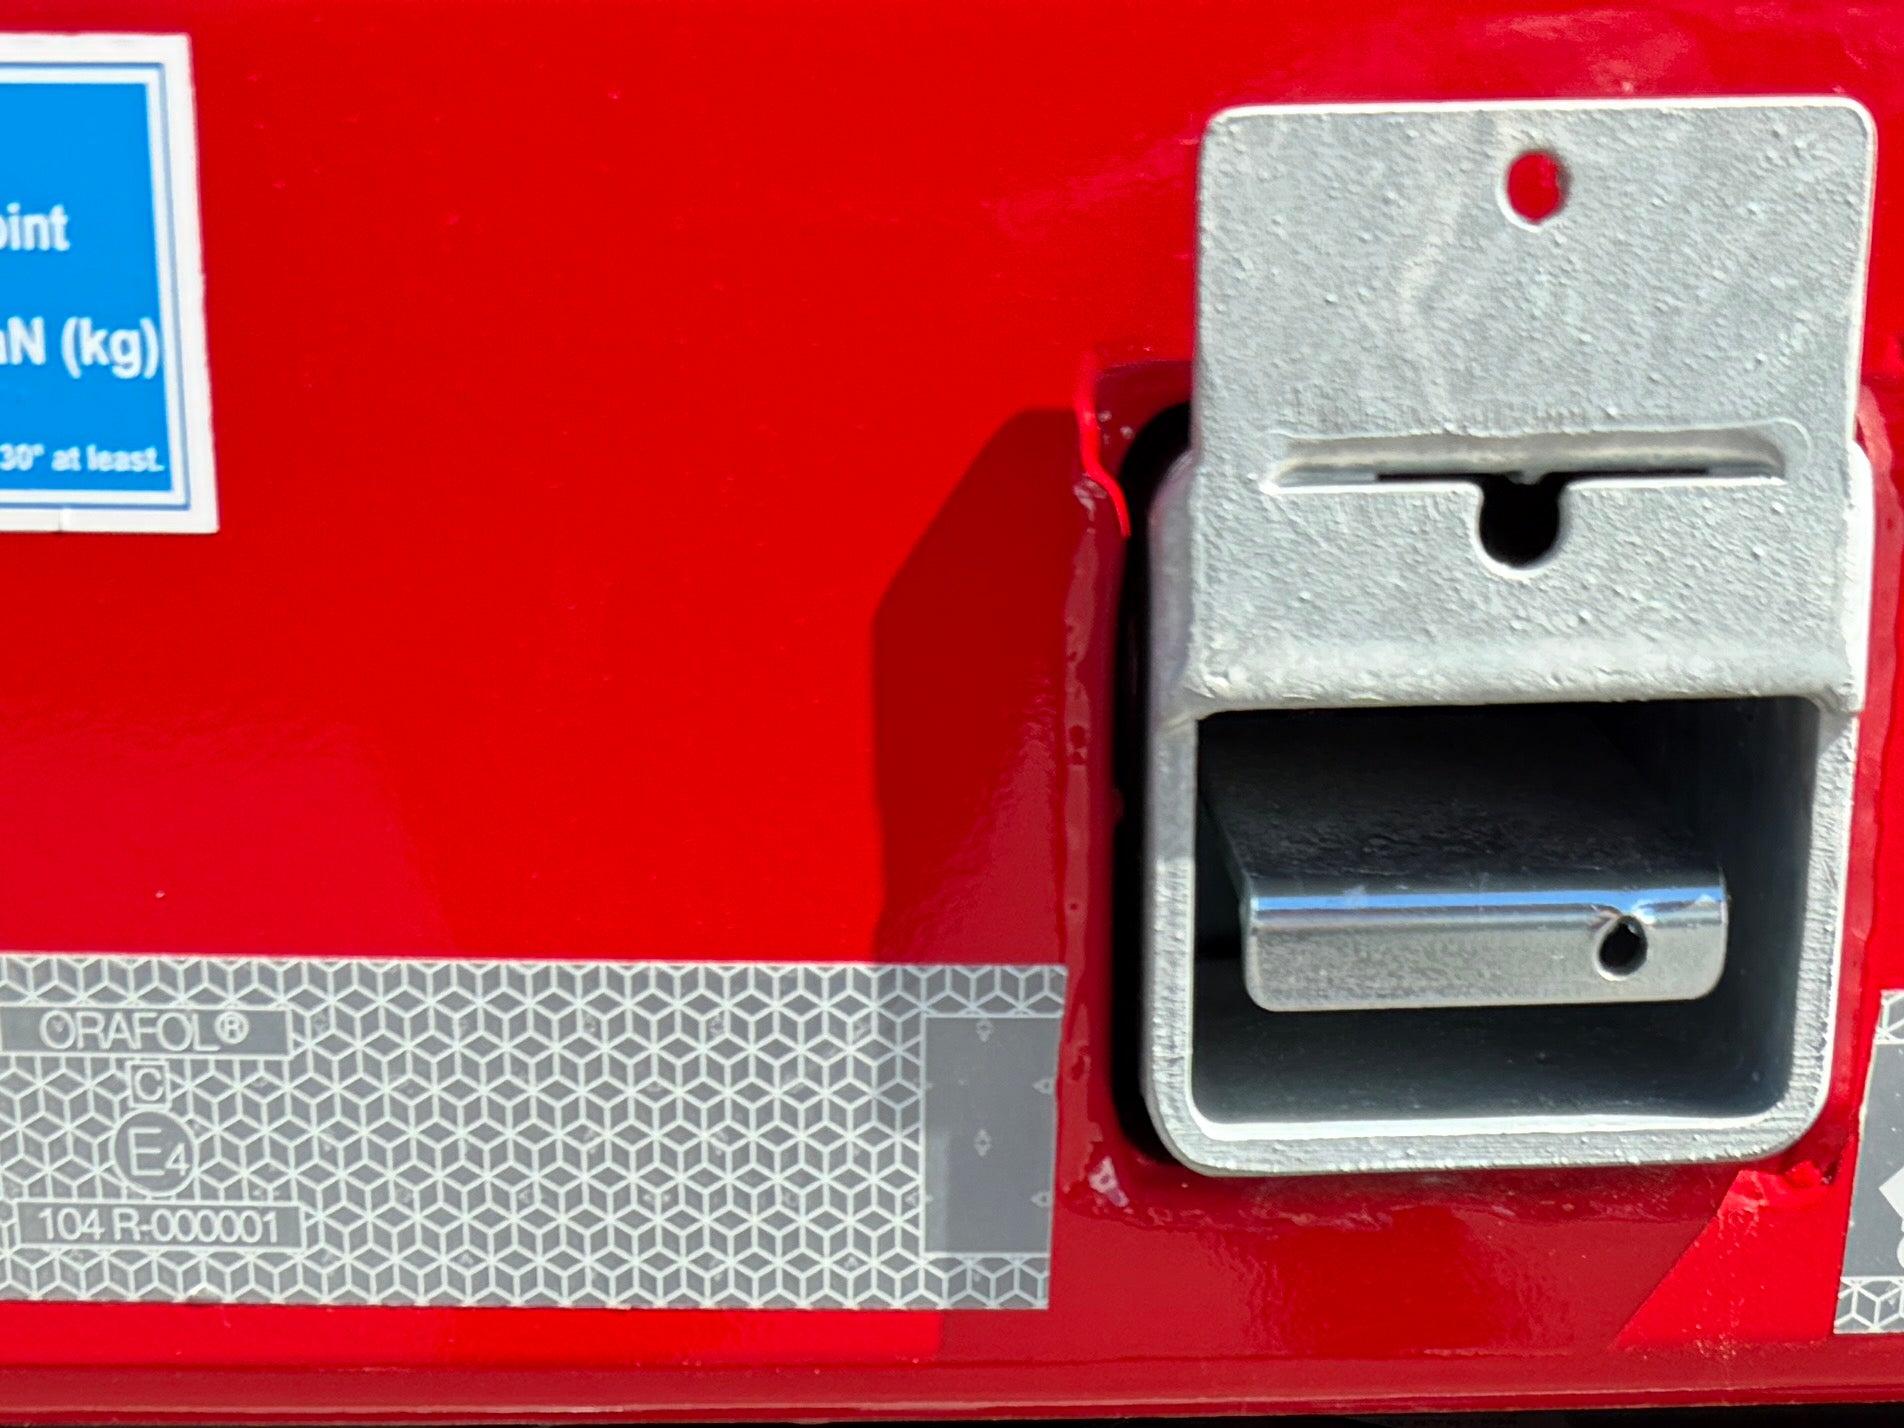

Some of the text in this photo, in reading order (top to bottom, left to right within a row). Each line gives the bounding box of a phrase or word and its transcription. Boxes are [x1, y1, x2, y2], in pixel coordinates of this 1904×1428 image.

[62, 318, 161, 378] (kg)
[51, 446, 82, 472] at
[88, 444, 165, 474] least.
[133, 1066, 163, 1101] C
[38, 1207, 279, 1243] 104 R-000001
